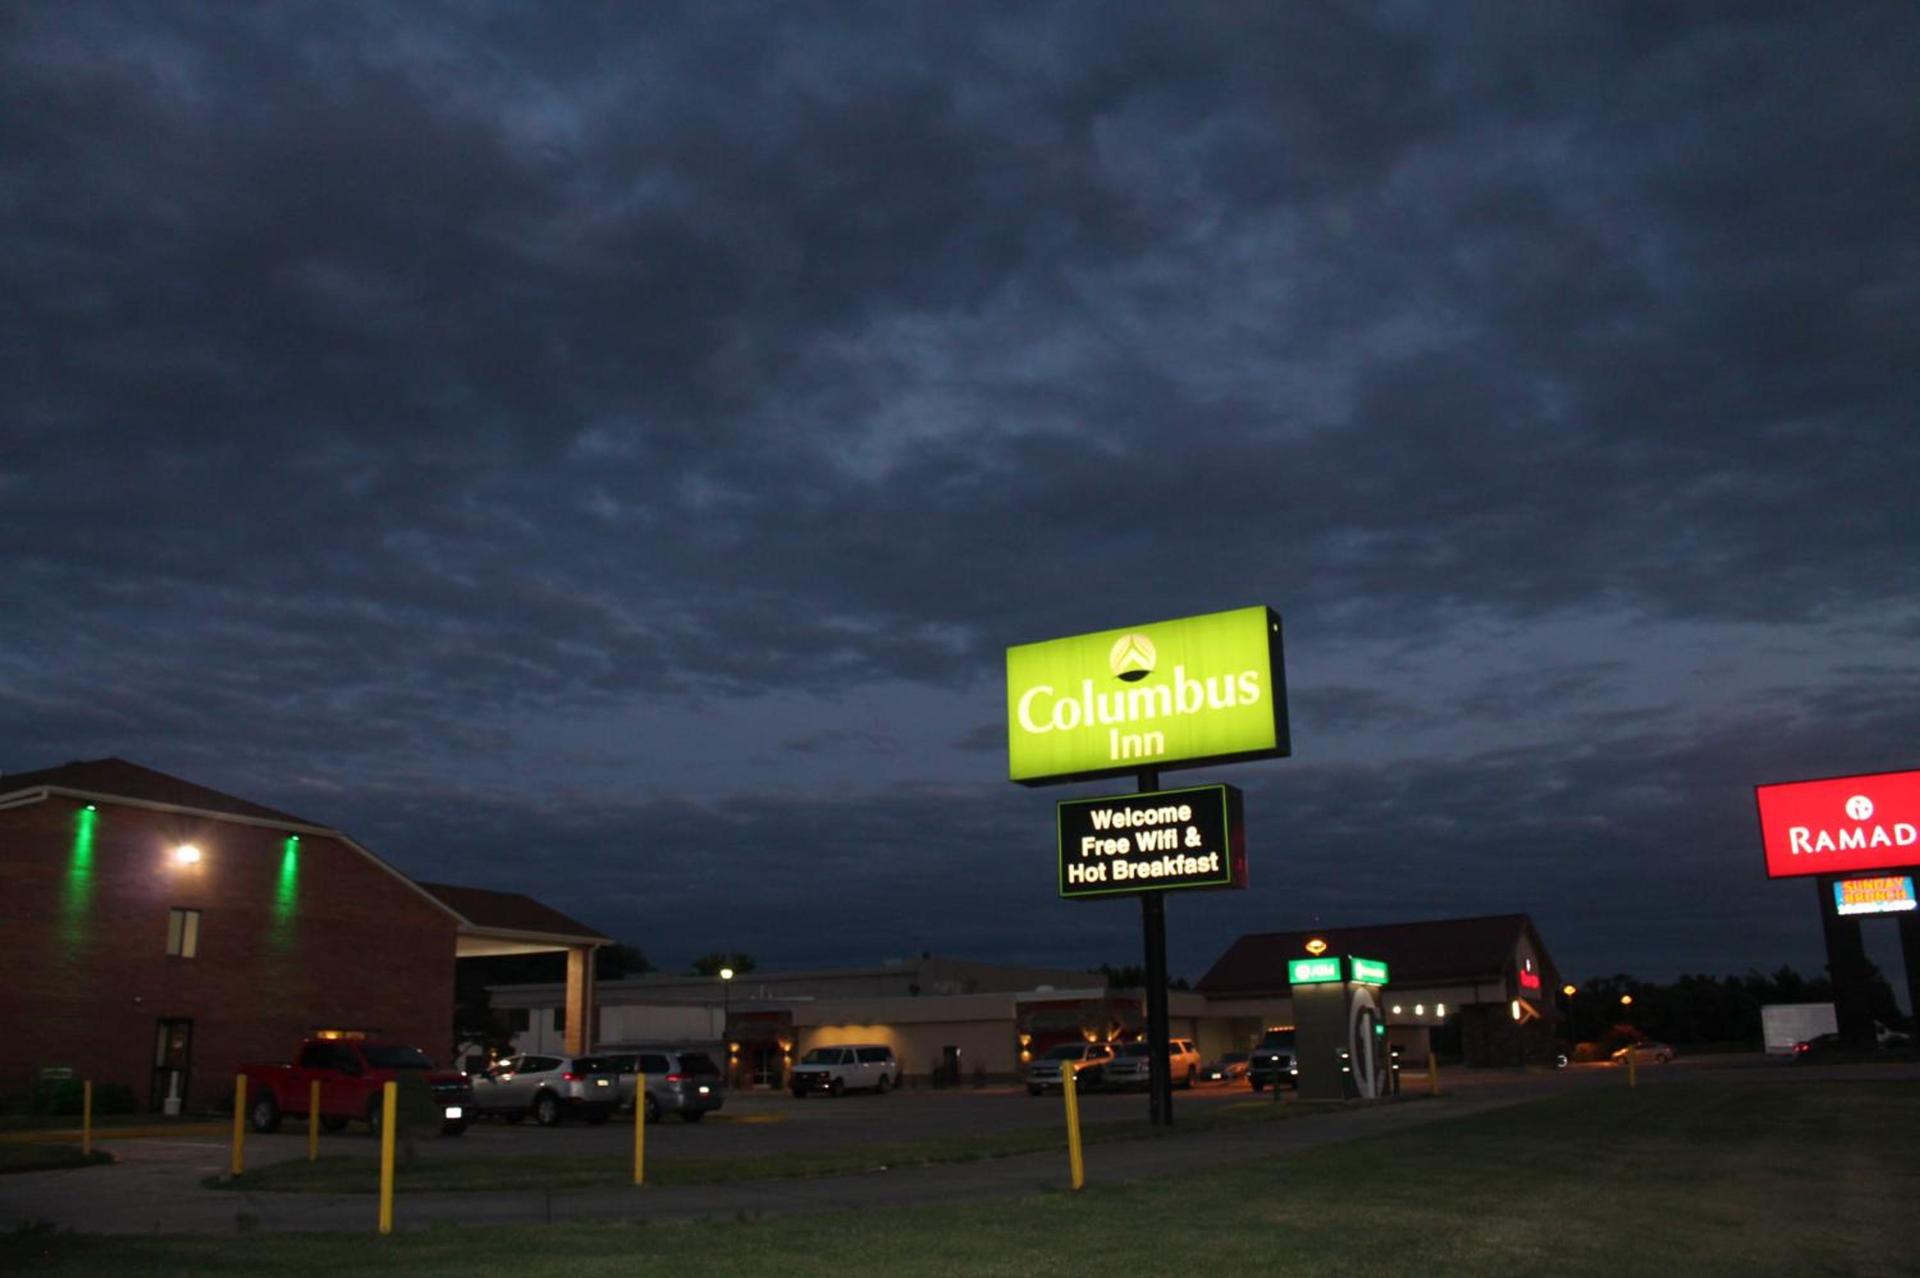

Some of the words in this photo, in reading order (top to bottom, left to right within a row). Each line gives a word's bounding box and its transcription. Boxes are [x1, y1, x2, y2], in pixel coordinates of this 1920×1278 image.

[1017, 665, 1260, 734] Columbus
[1110, 728, 1165, 760] Inn
[1091, 803, 1192, 830] Welcome
[1082, 836, 1130, 857] Free
[1136, 829, 1177, 852] Wifi
[1184, 826, 1202, 848] &
[1068, 863, 1107, 884] Hot
[1112, 852, 1220, 881] Breakfast
